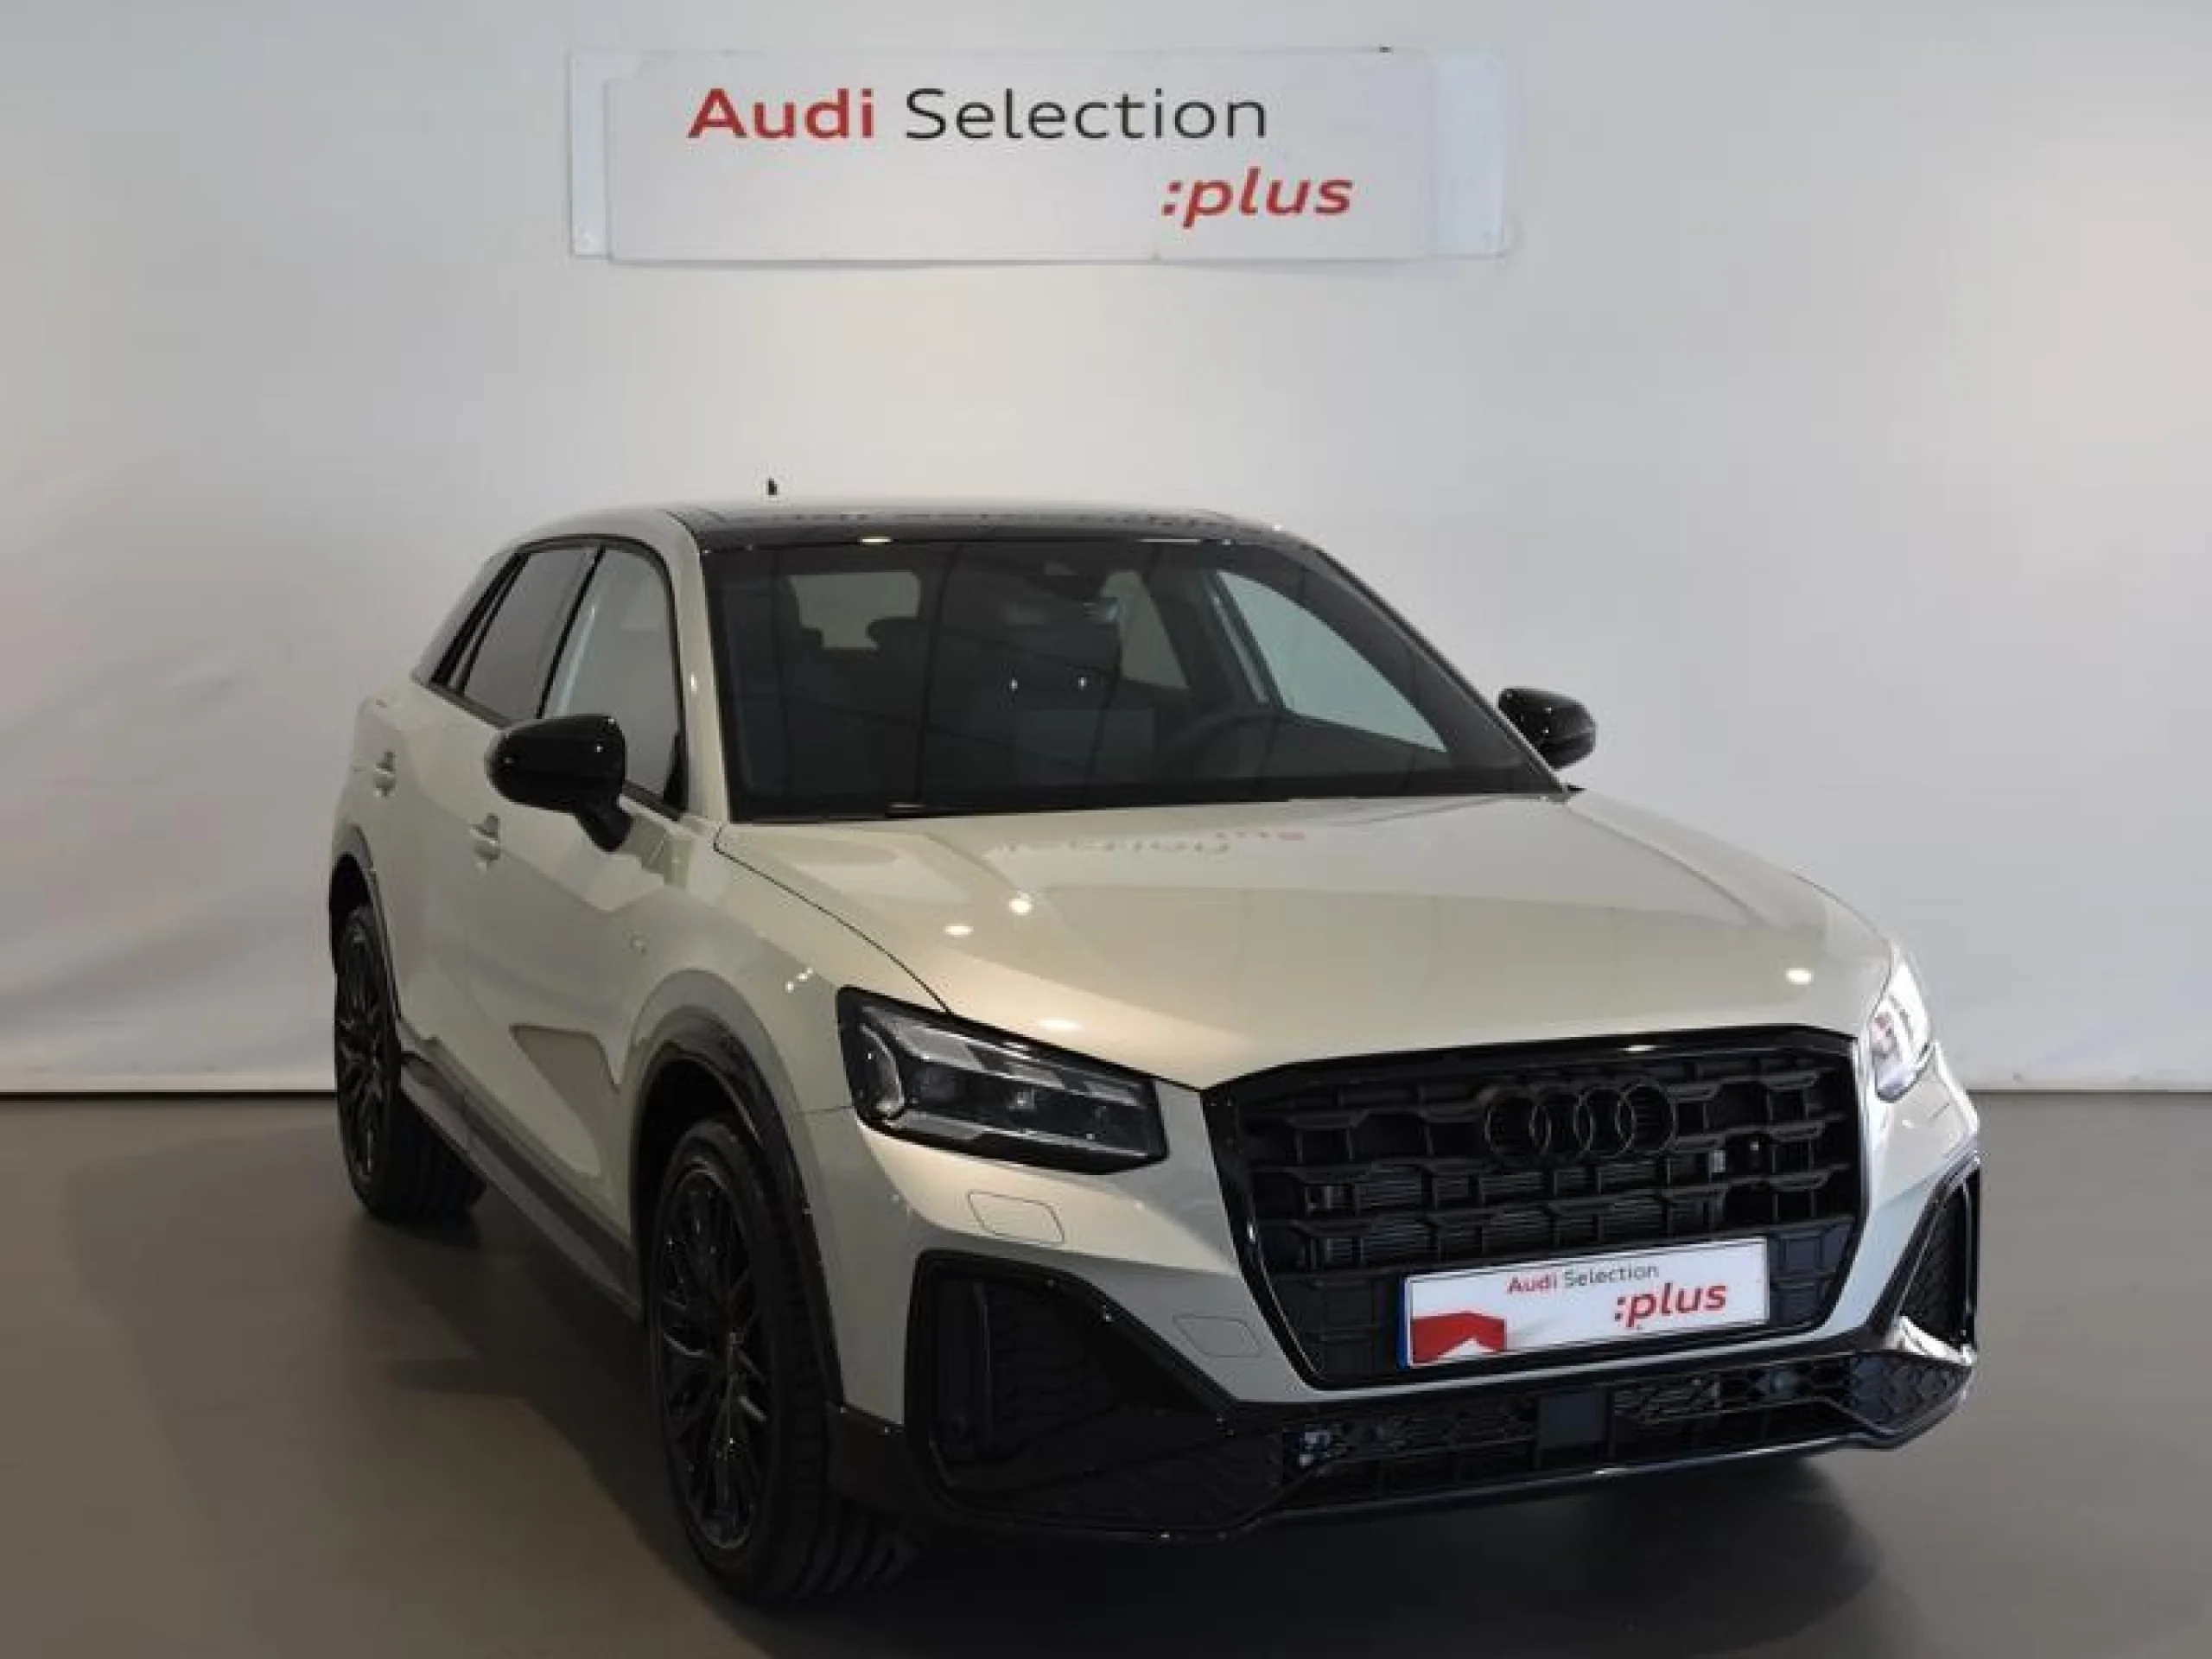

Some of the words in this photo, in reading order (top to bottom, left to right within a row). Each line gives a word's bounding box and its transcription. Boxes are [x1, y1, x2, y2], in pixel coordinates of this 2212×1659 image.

[689, 88, 874, 140] Audi
[906, 87, 1267, 139] Selection
[1161, 168, 1353, 227] :plus
[1508, 1274, 1558, 1294] Audi
[1564, 1264, 1659, 1288] Selection
[1614, 1282, 1727, 1328] :plus
